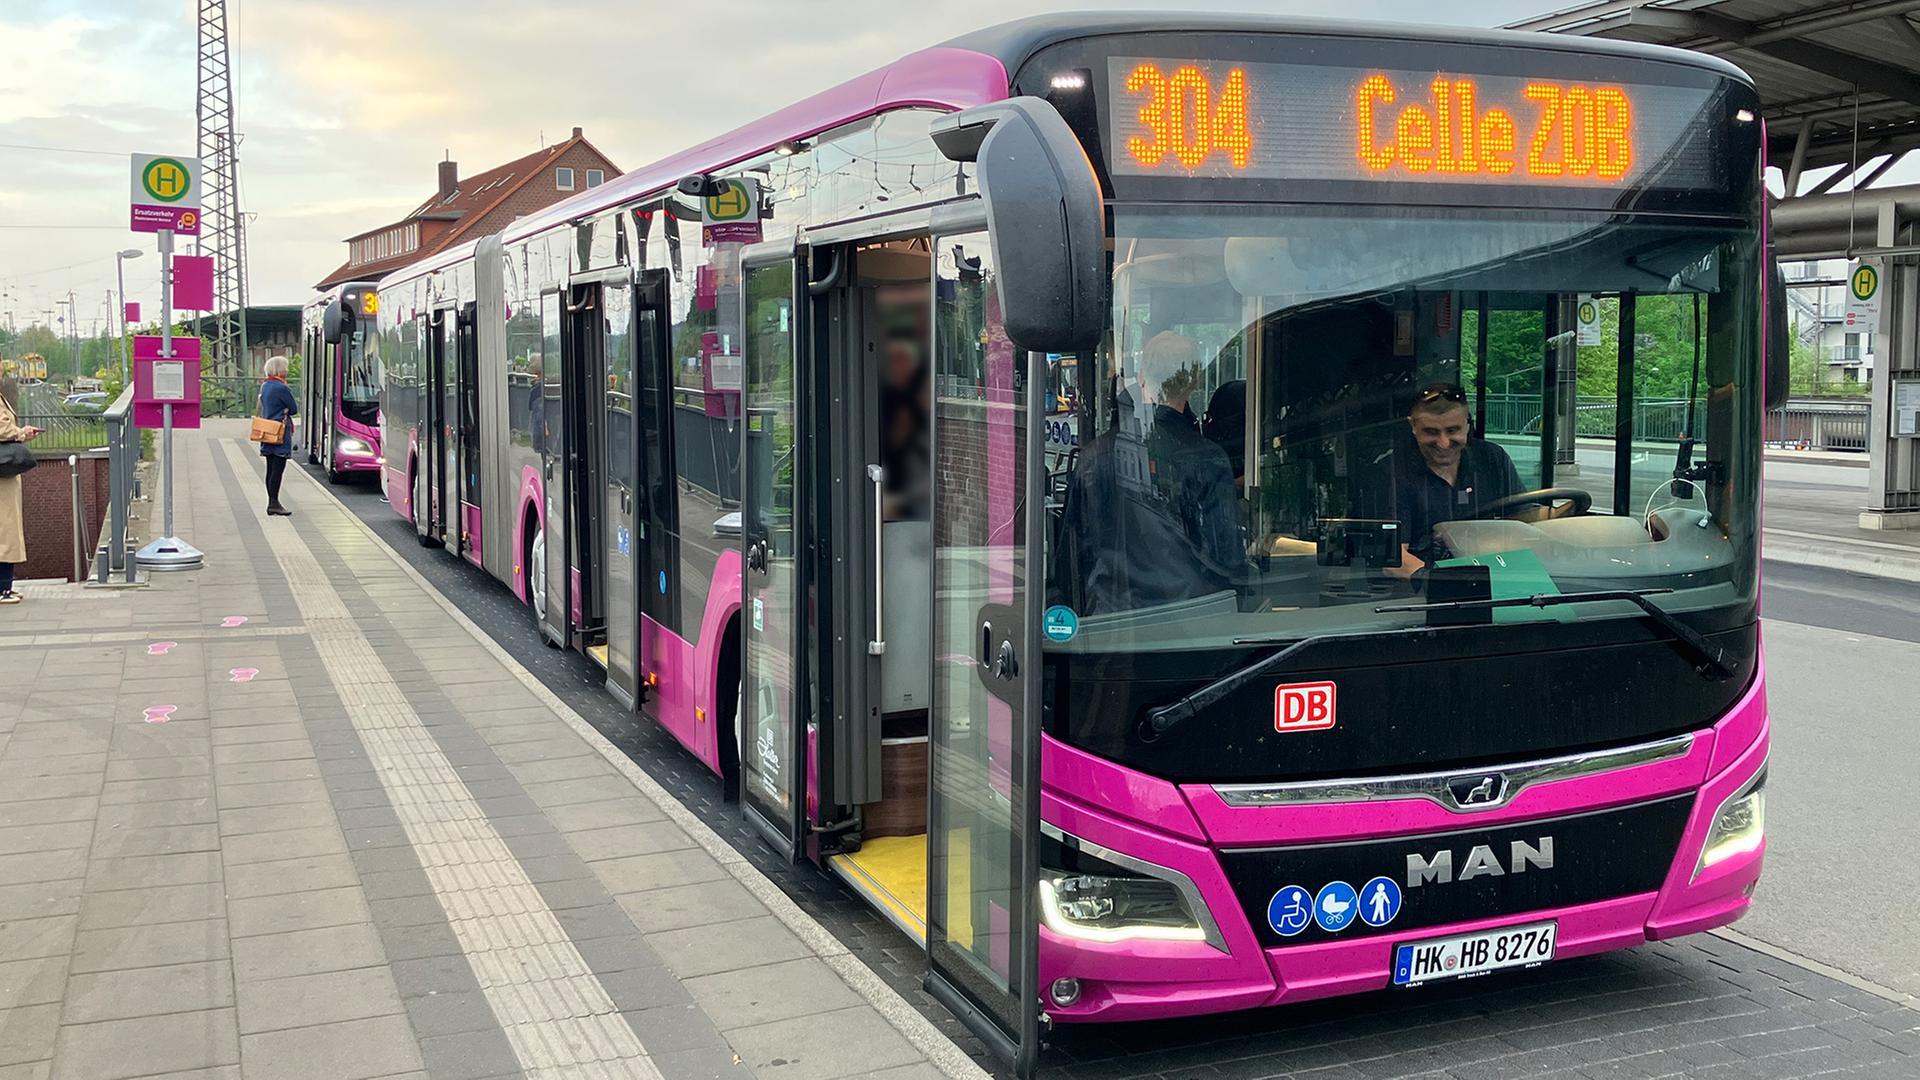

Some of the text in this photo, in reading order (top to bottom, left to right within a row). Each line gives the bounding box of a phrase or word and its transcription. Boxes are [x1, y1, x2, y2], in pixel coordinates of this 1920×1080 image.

[1126, 64, 1632, 179] 304 Celle ZOB
[156, 167, 177, 193] H
[134, 208, 174, 217] Ersatzverkehr
[1858, 272, 1871, 293] H
[1055, 610, 1065, 625] 4
[1283, 690, 1328, 723] DB
[1406, 836, 1554, 888] MAN
[1414, 929, 1550, 976] HK HB 8276
[1400, 967, 1407, 977] D
